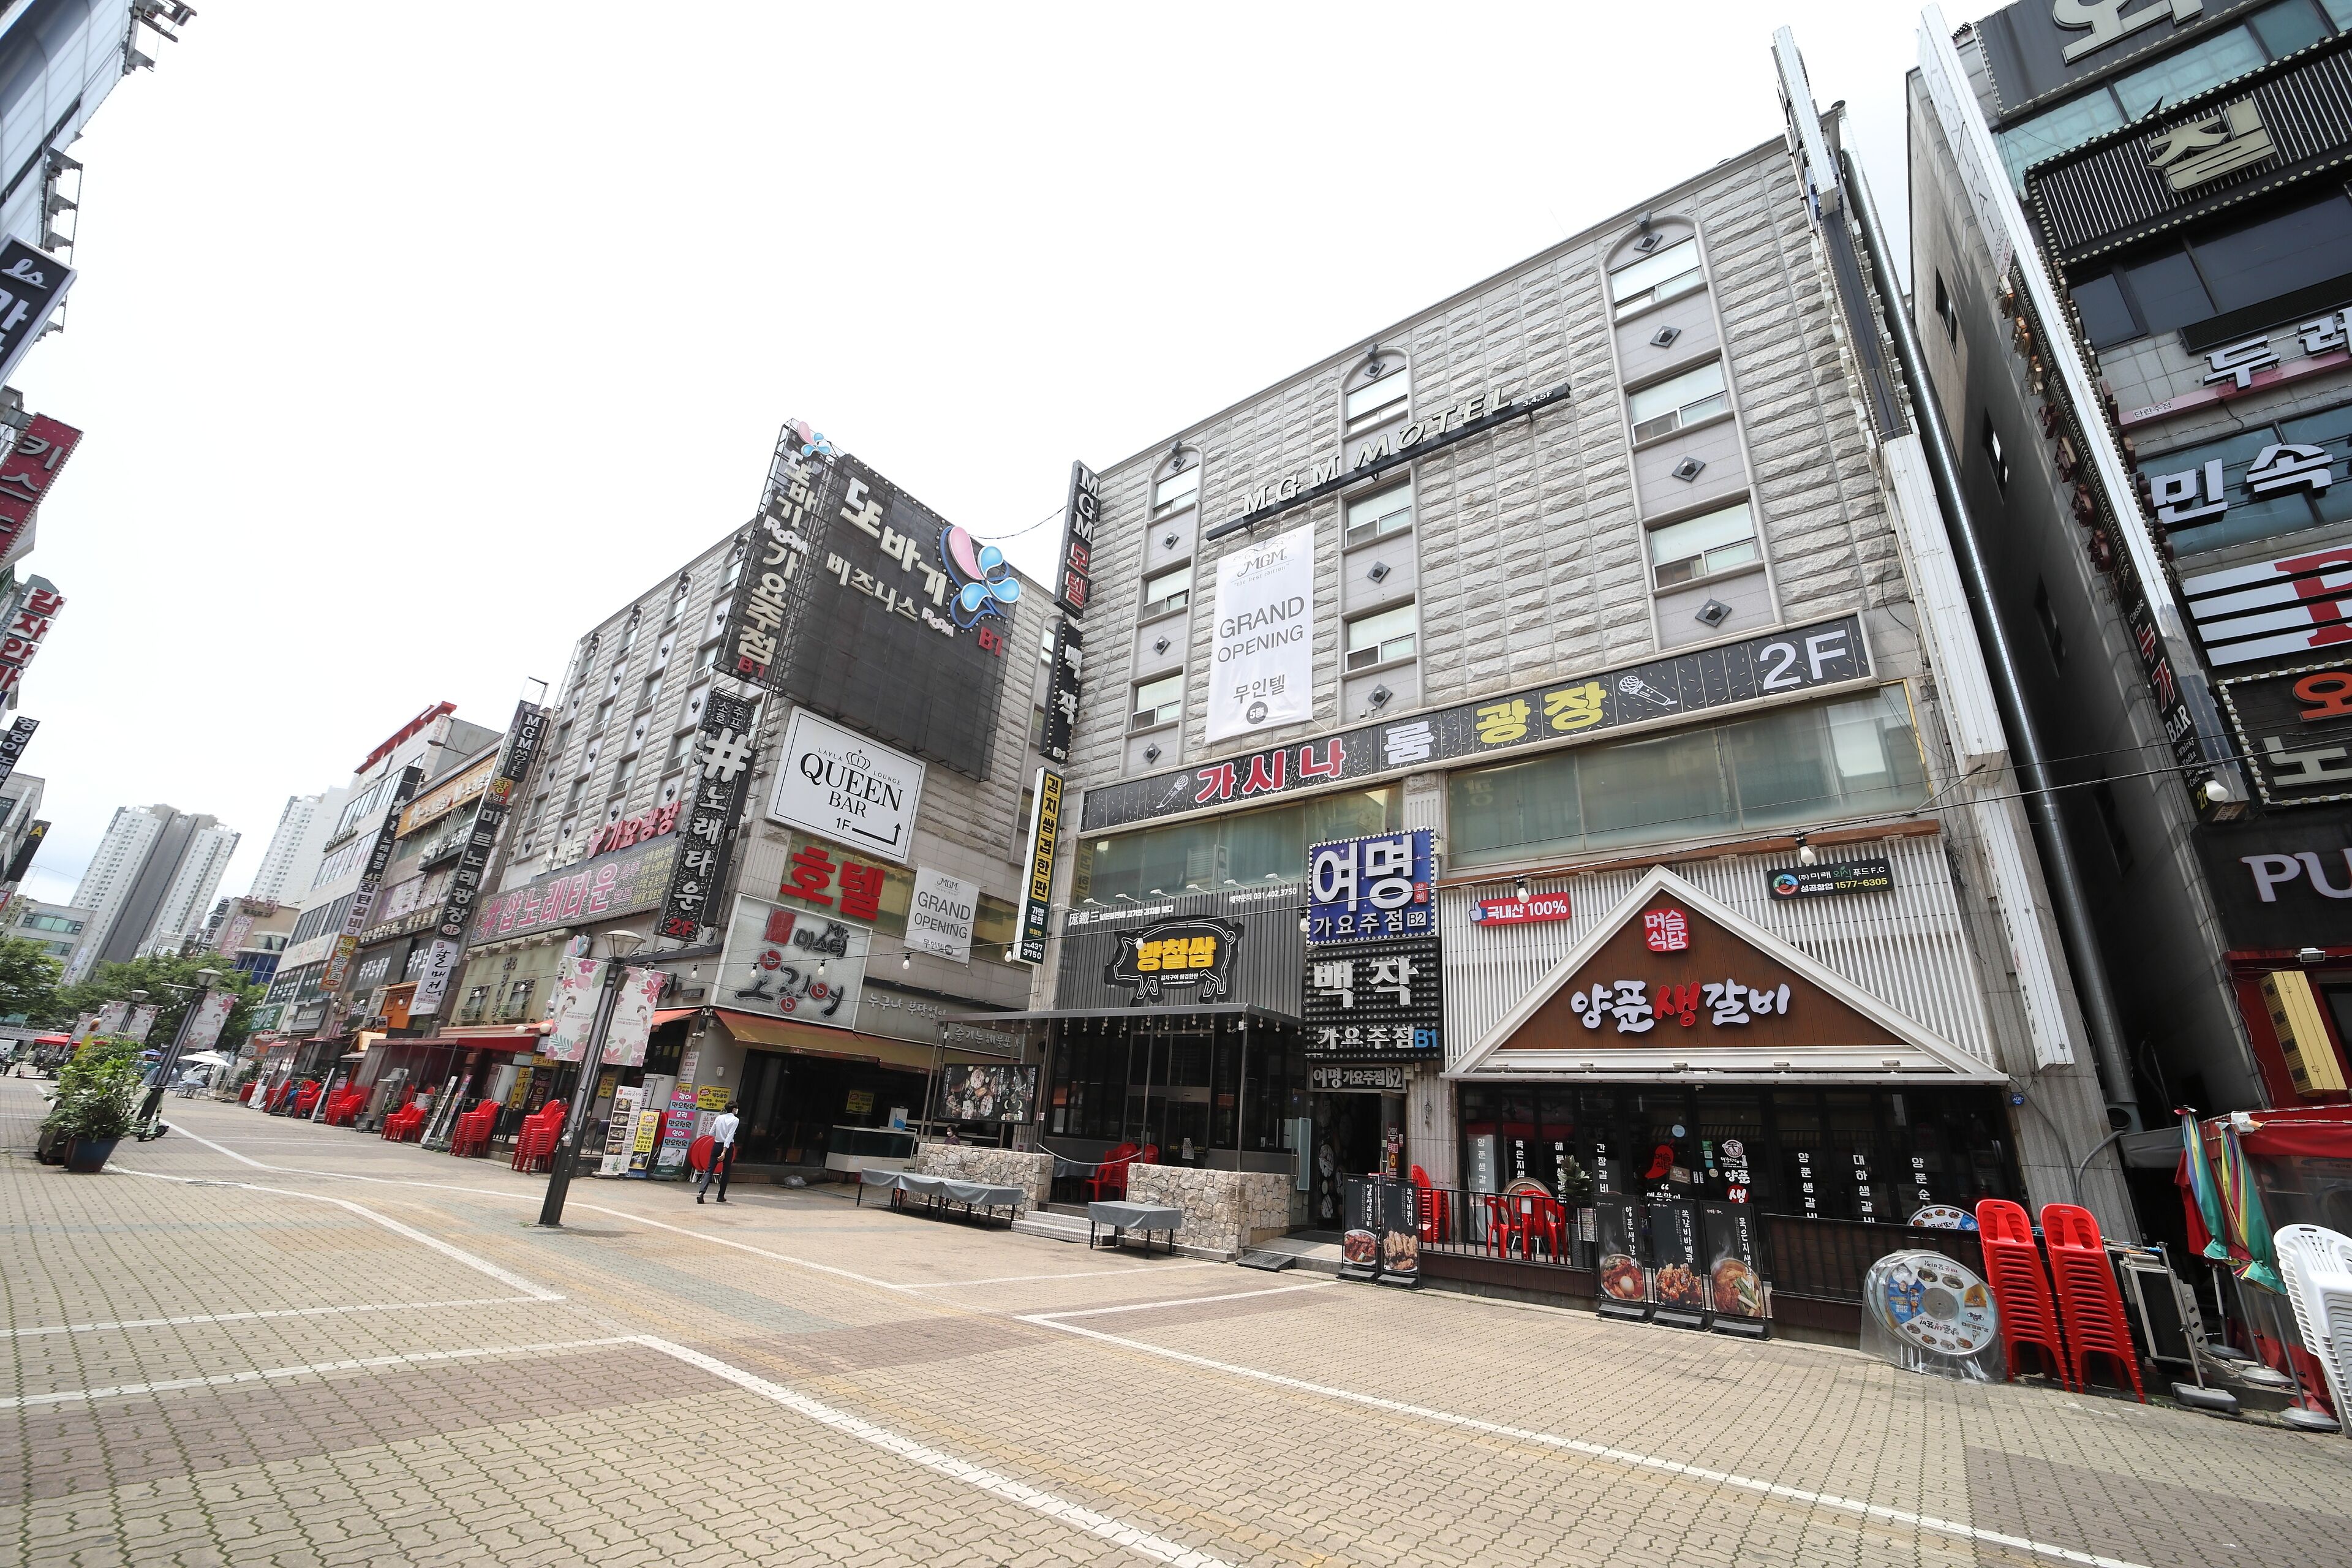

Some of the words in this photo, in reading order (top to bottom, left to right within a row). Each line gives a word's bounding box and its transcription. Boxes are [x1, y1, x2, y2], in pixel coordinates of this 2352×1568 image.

[2133, 402, 2172, 419] 단란주점
[1353, 386, 1514, 470] MOTEL
[2150, 442, 2335, 525] 민속
[1072, 466, 1099, 545] MGM
[1066, 542, 1090, 608] 모텔
[1237, 548, 1287, 578] MGM
[826, 551, 919, 623] 비즈니스
[737, 540, 799, 666] 가요주점
[1219, 595, 1305, 639] GRAND
[2128, 598, 2145, 625] Classic
[978, 626, 1003, 658] B1
[1217, 624, 1304, 663] OPENING
[737, 657, 769, 679] B1
[2135, 621, 2176, 714] 누가
[1057, 643, 1084, 725] 백작
[1233, 673, 1286, 704] 무인텔
[517, 714, 541, 750] MGM
[1195, 737, 1347, 804] 가시나
[1384, 720, 1434, 764] 룸
[1475, 680, 1607, 744] 광장
[1758, 630, 1847, 690] 2F
[2165, 704, 2192, 746] BAR
[510, 749, 528, 777] MOTEL
[818, 747, 843, 762] LAYLA
[800, 752, 904, 812] QUEEN
[873, 770, 902, 786] LOUNGE
[828, 790, 867, 818] BAR
[835, 817, 851, 831] 1F
[364, 872, 382, 882] 4F
[780, 846, 886, 922] 호텔
[1313, 834, 1414, 912] 여명
[1800, 883, 1834, 893] 성공창업
[1834, 877, 1888, 889] 1577-6305
[1810, 871, 1831, 880] 미래
[1853, 867, 1870, 877] 푸드
[918, 891, 971, 921] GRAND
[1253, 887, 1297, 901] 031.402.3750
[1313, 908, 1404, 937] 가요주점
[1407, 910, 1427, 927] B2
[1487, 902, 1525, 921] 국내산
[1527, 899, 1567, 918] 100%
[1645, 910, 1686, 931] 머슴
[445, 925, 459, 935] 3F
[668, 916, 696, 935] 2F
[914, 912, 968, 939] OPENING
[1647, 930, 1687, 951] 식당
[1023, 949, 1042, 960] 3750
[1136, 936, 1218, 972] 방철쌈
[1313, 955, 1419, 1008] 백작
[868, 992, 903, 1011] 누구나
[1570, 977, 1791, 1034] 양푼생갈비
[954, 1026, 984, 1045] 즐기는
[1317, 1026, 1415, 1051] 가요주점
[1414, 1028, 1438, 1048] B1
[1313, 1068, 1343, 1089] 여명
[1343, 1068, 1385, 1088] 가요주점
[1385, 1066, 1403, 1088] B2
[1596, 1143, 1609, 1193] 간장갈비
[1911, 1156, 1931, 1209] 양푼순
[1728, 1188, 1746, 1204] 생
[1625, 1206, 1638, 1268] 양푼생갈비
[1681, 1209, 1694, 1264] 쪽갈비바베큐
